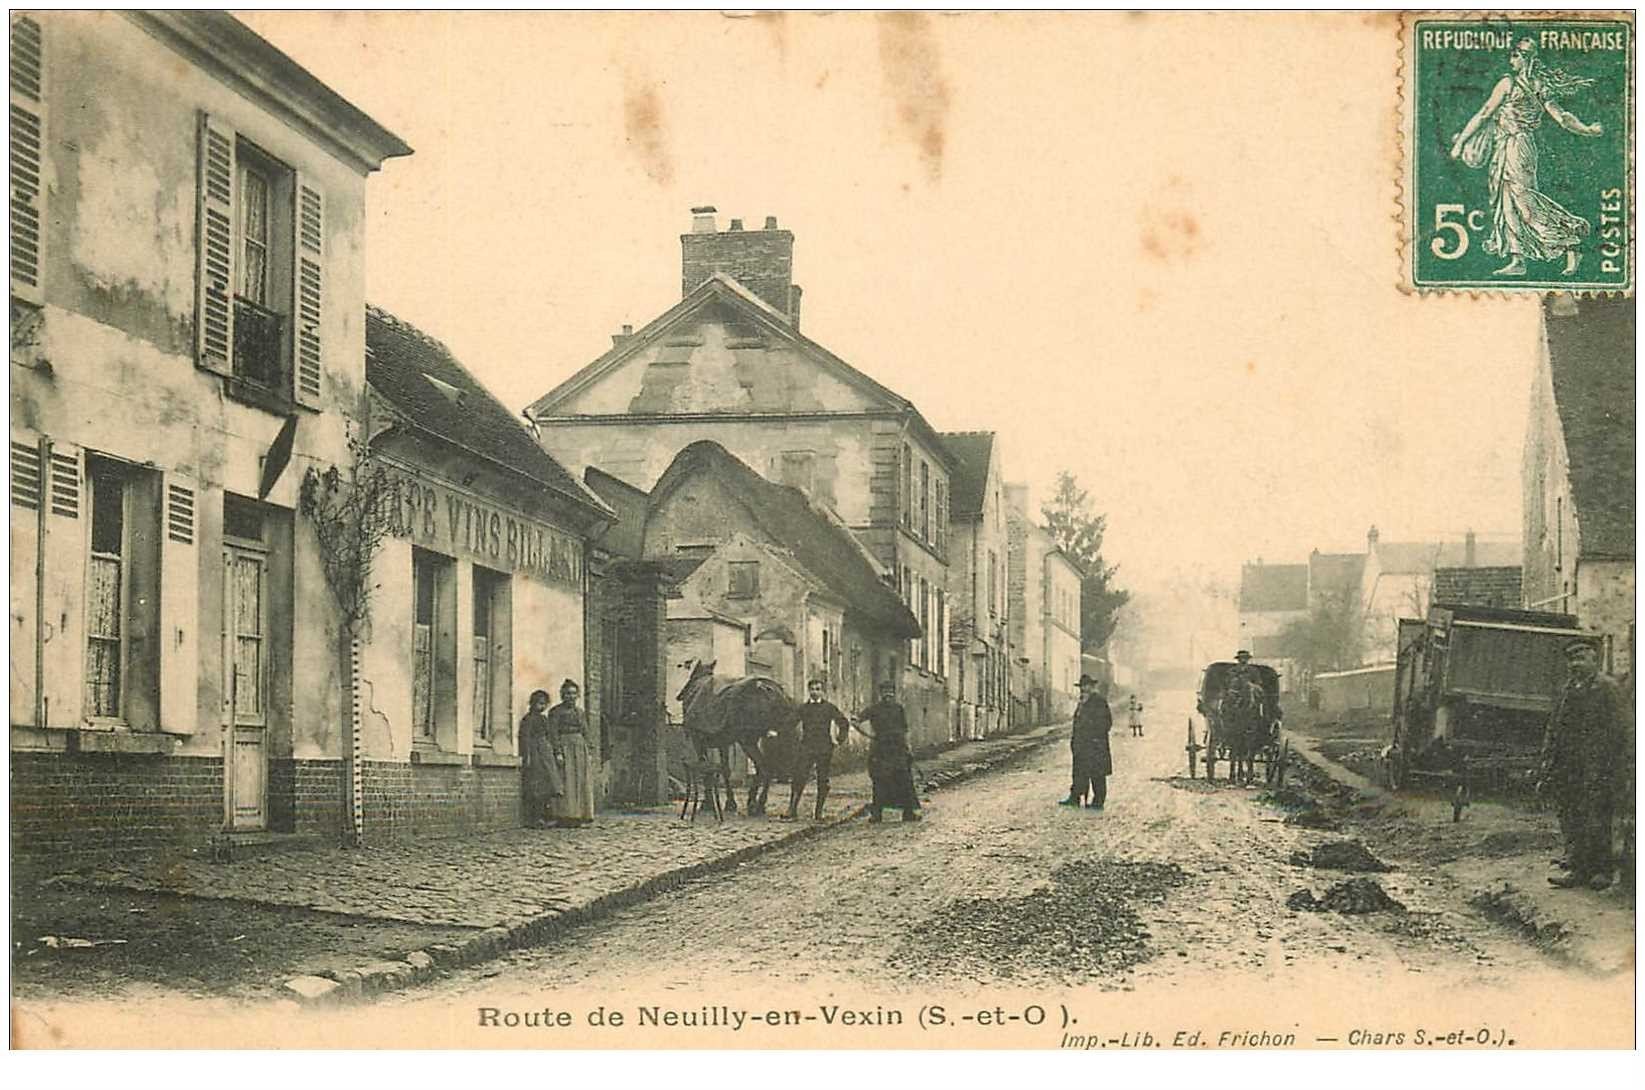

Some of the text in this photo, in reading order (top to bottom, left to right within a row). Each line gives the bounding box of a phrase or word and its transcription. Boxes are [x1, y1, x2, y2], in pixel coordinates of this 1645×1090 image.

[1540, 31, 1624, 53] FRANÇAISE
[1601, 188, 1622, 273] POSTES
[370, 466, 437, 537] AFE
[446, 493, 501, 560] VINS
